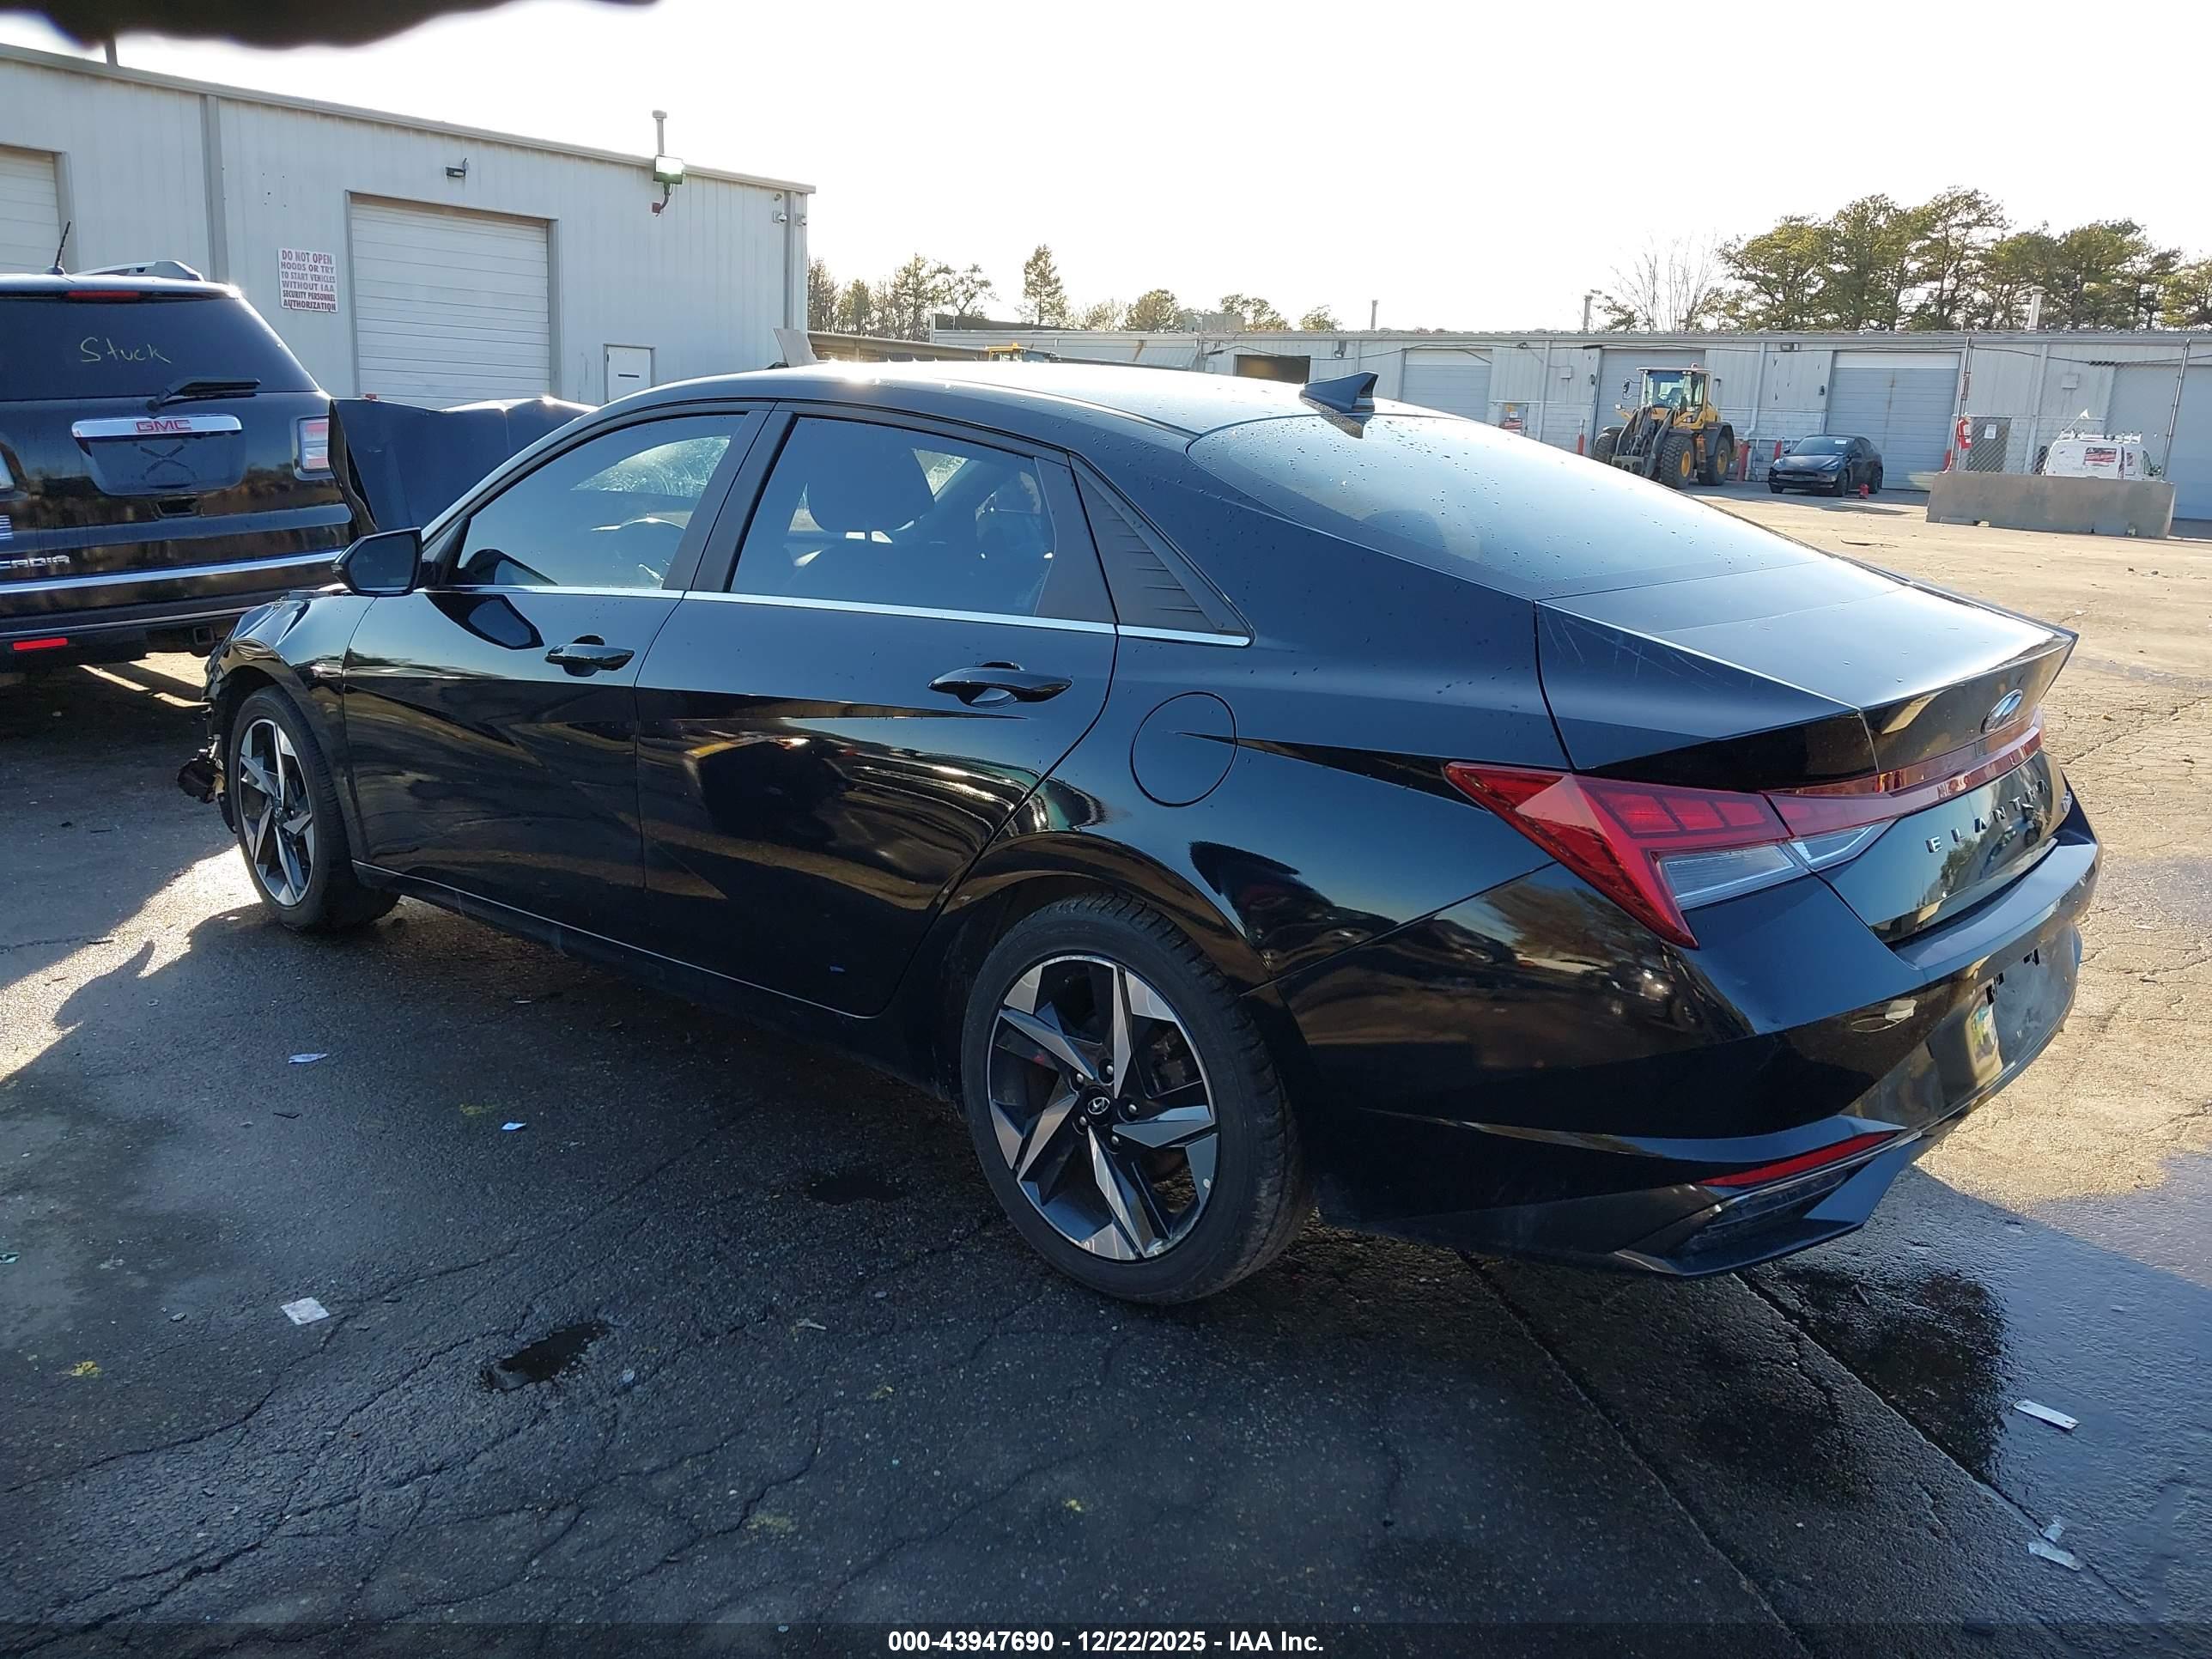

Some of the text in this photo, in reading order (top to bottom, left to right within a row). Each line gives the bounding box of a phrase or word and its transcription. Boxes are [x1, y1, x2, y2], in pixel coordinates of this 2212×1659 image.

[282, 250, 332, 264] DO NOT OPEN
[281, 262, 307, 271] HOODS
[320, 265, 335, 274] TRY
[291, 272, 308, 281] START
[310, 274, 336, 283] VEHICLES
[282, 281, 334, 292] WITHOUT IAA
[283, 289, 336, 301] SECURITY PERSONNEL
[283, 299, 337, 311] AUTHORIZATION
[80, 337, 172, 363] Stuck
[136, 419, 191, 433] GMC
[1925, 779, 2049, 854] ELANTRA
